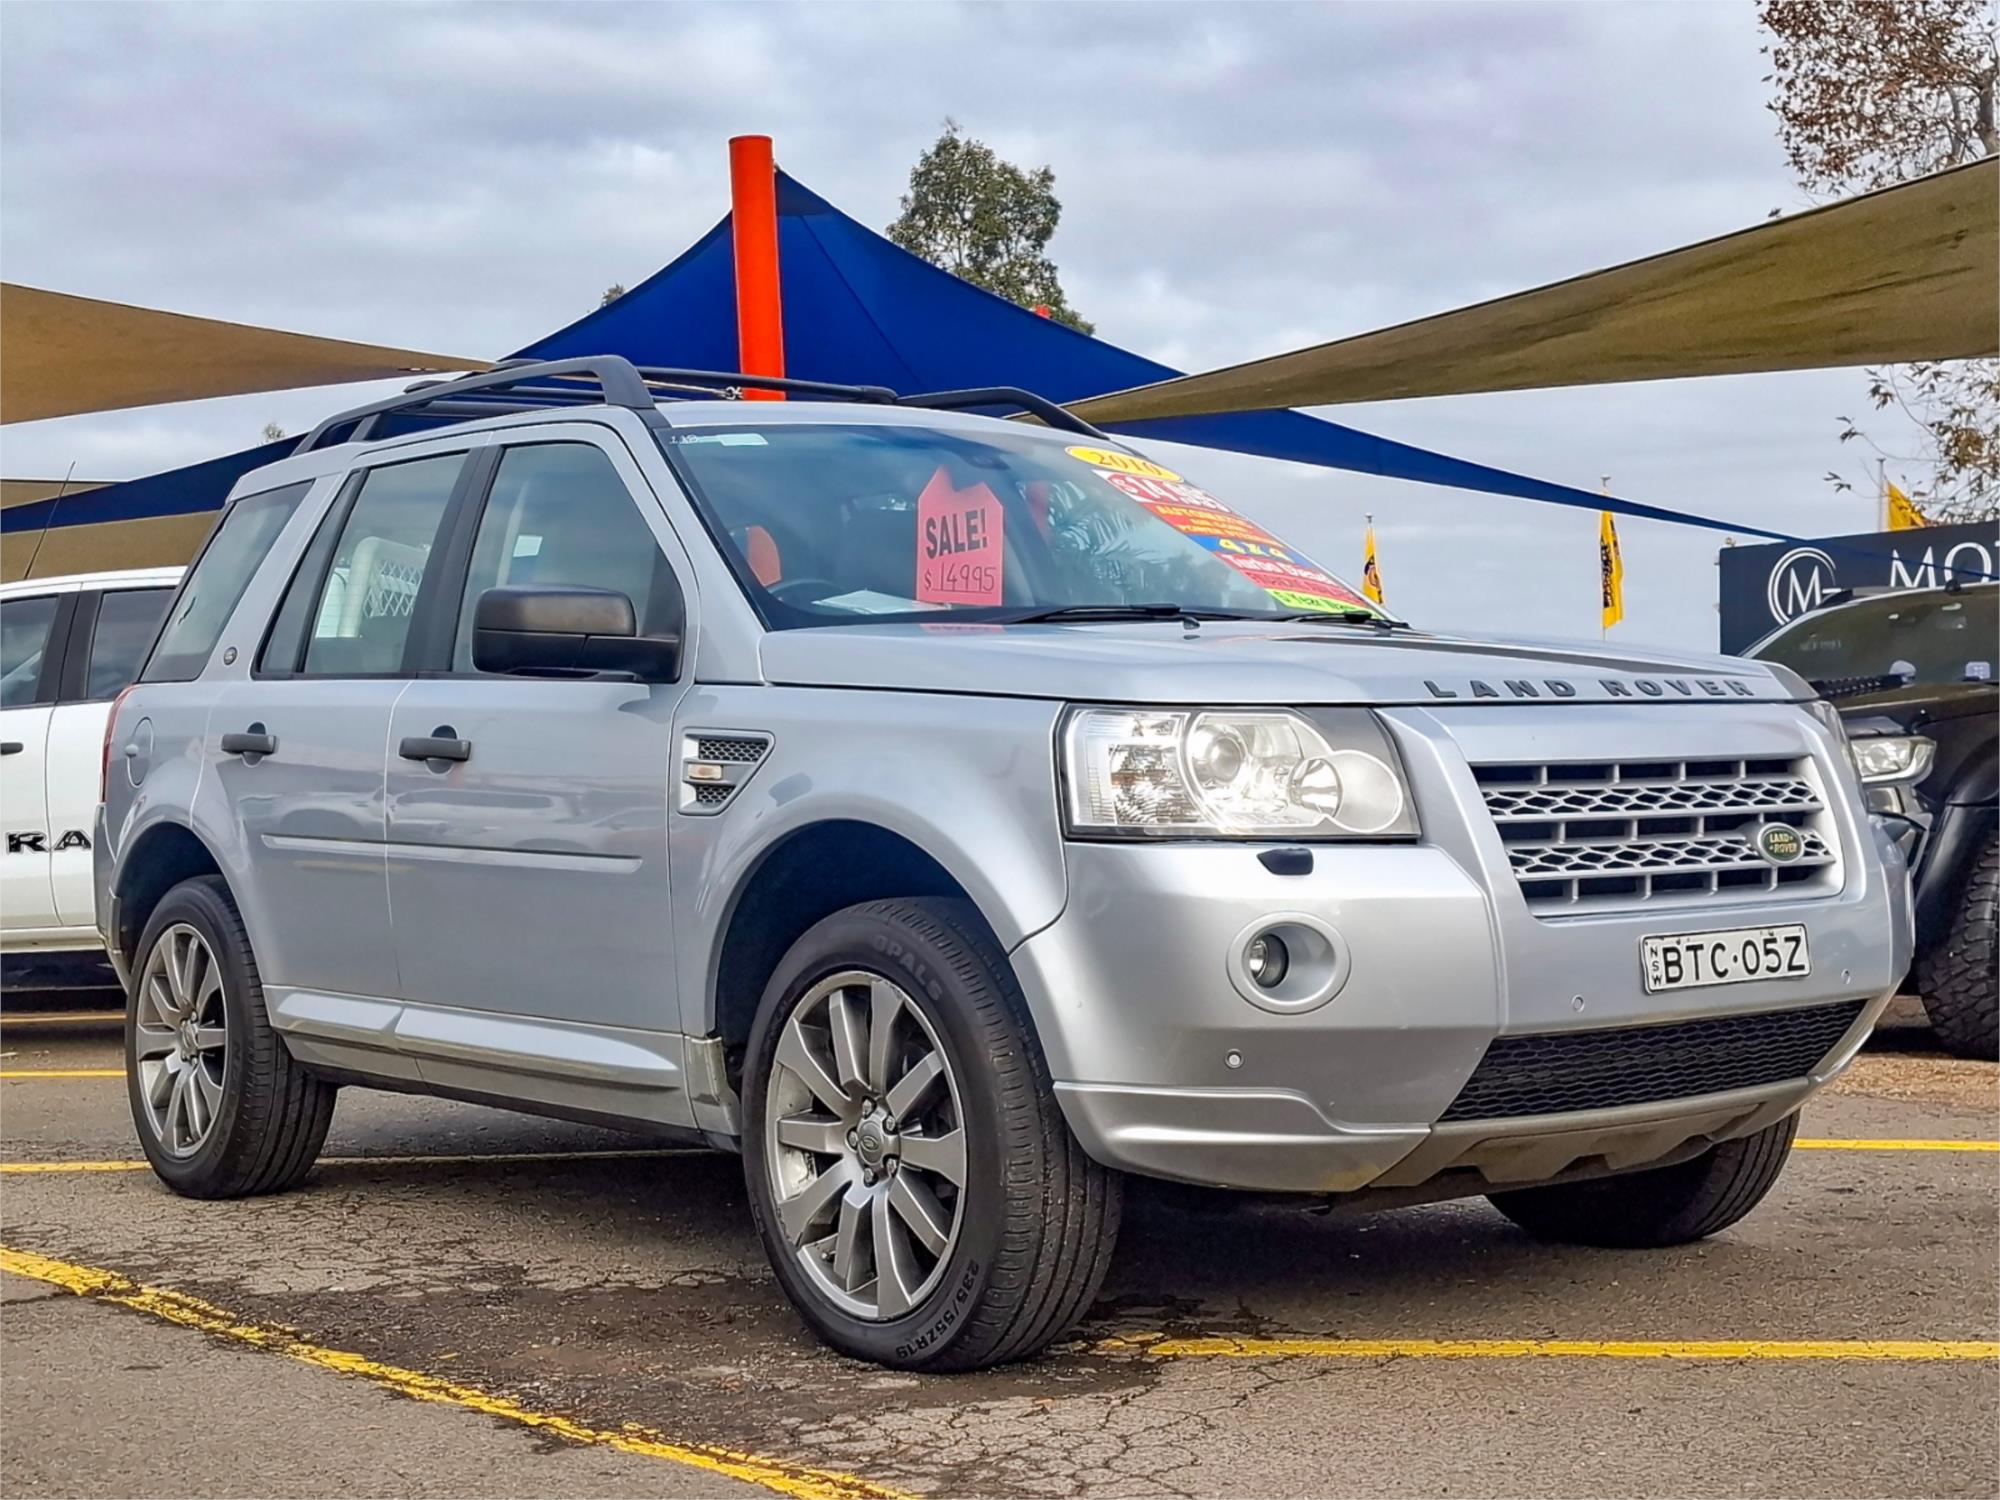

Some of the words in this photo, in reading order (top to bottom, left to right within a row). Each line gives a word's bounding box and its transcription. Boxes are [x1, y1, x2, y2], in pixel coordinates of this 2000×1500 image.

[1089, 451, 1162, 476] 2010
[926, 508, 988, 559] SALE!
[1890, 540, 2000, 589] MO
[1424, 680, 1576, 698] LAND
[1598, 679, 1755, 697] ROVER
